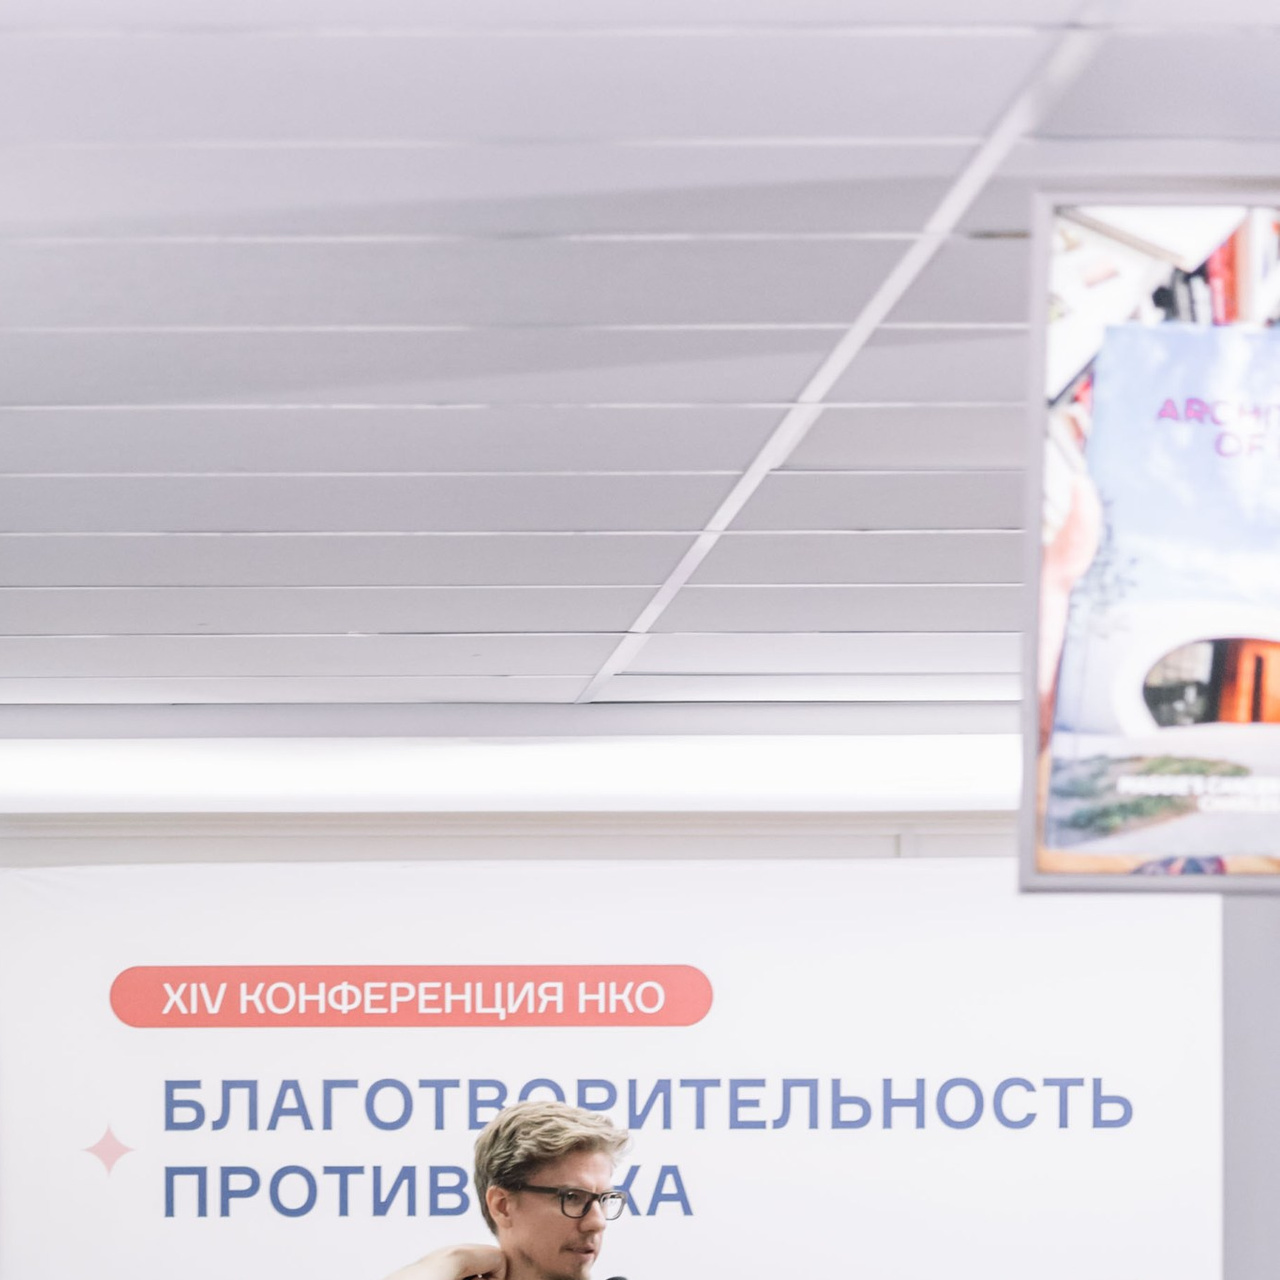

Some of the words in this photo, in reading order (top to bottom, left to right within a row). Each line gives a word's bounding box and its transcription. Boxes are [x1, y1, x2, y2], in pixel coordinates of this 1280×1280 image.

[162, 982, 227, 1014] XIV
[240, 981, 564, 1020] КОНФЕРЕНЦИЯ
[578, 981, 665, 1014] НКО
[164, 1165, 471, 1218] ПРОТИВ
